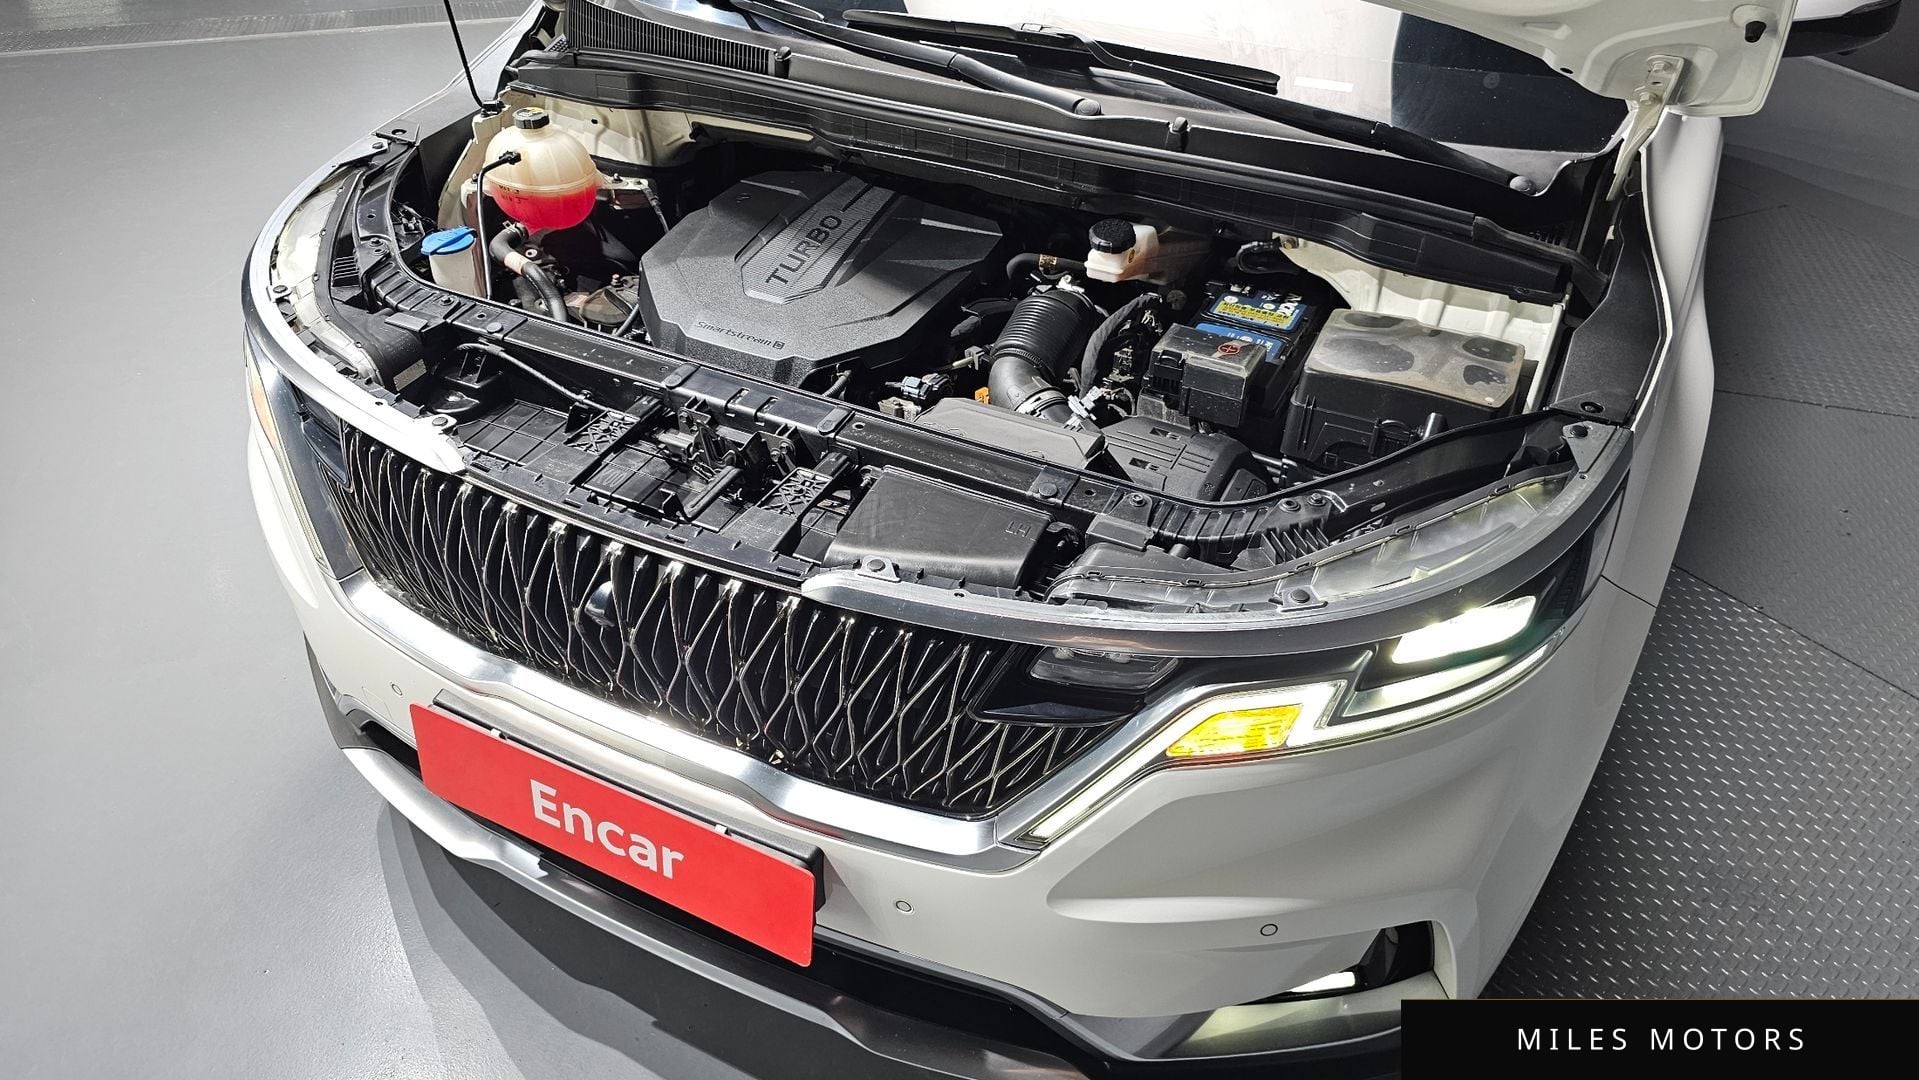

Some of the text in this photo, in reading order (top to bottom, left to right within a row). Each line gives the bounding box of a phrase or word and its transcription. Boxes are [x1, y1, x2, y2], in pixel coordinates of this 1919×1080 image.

[765, 215, 842, 285] TURBO
[696, 321, 772, 346] Smartstream
[529, 778, 685, 880] Encar
